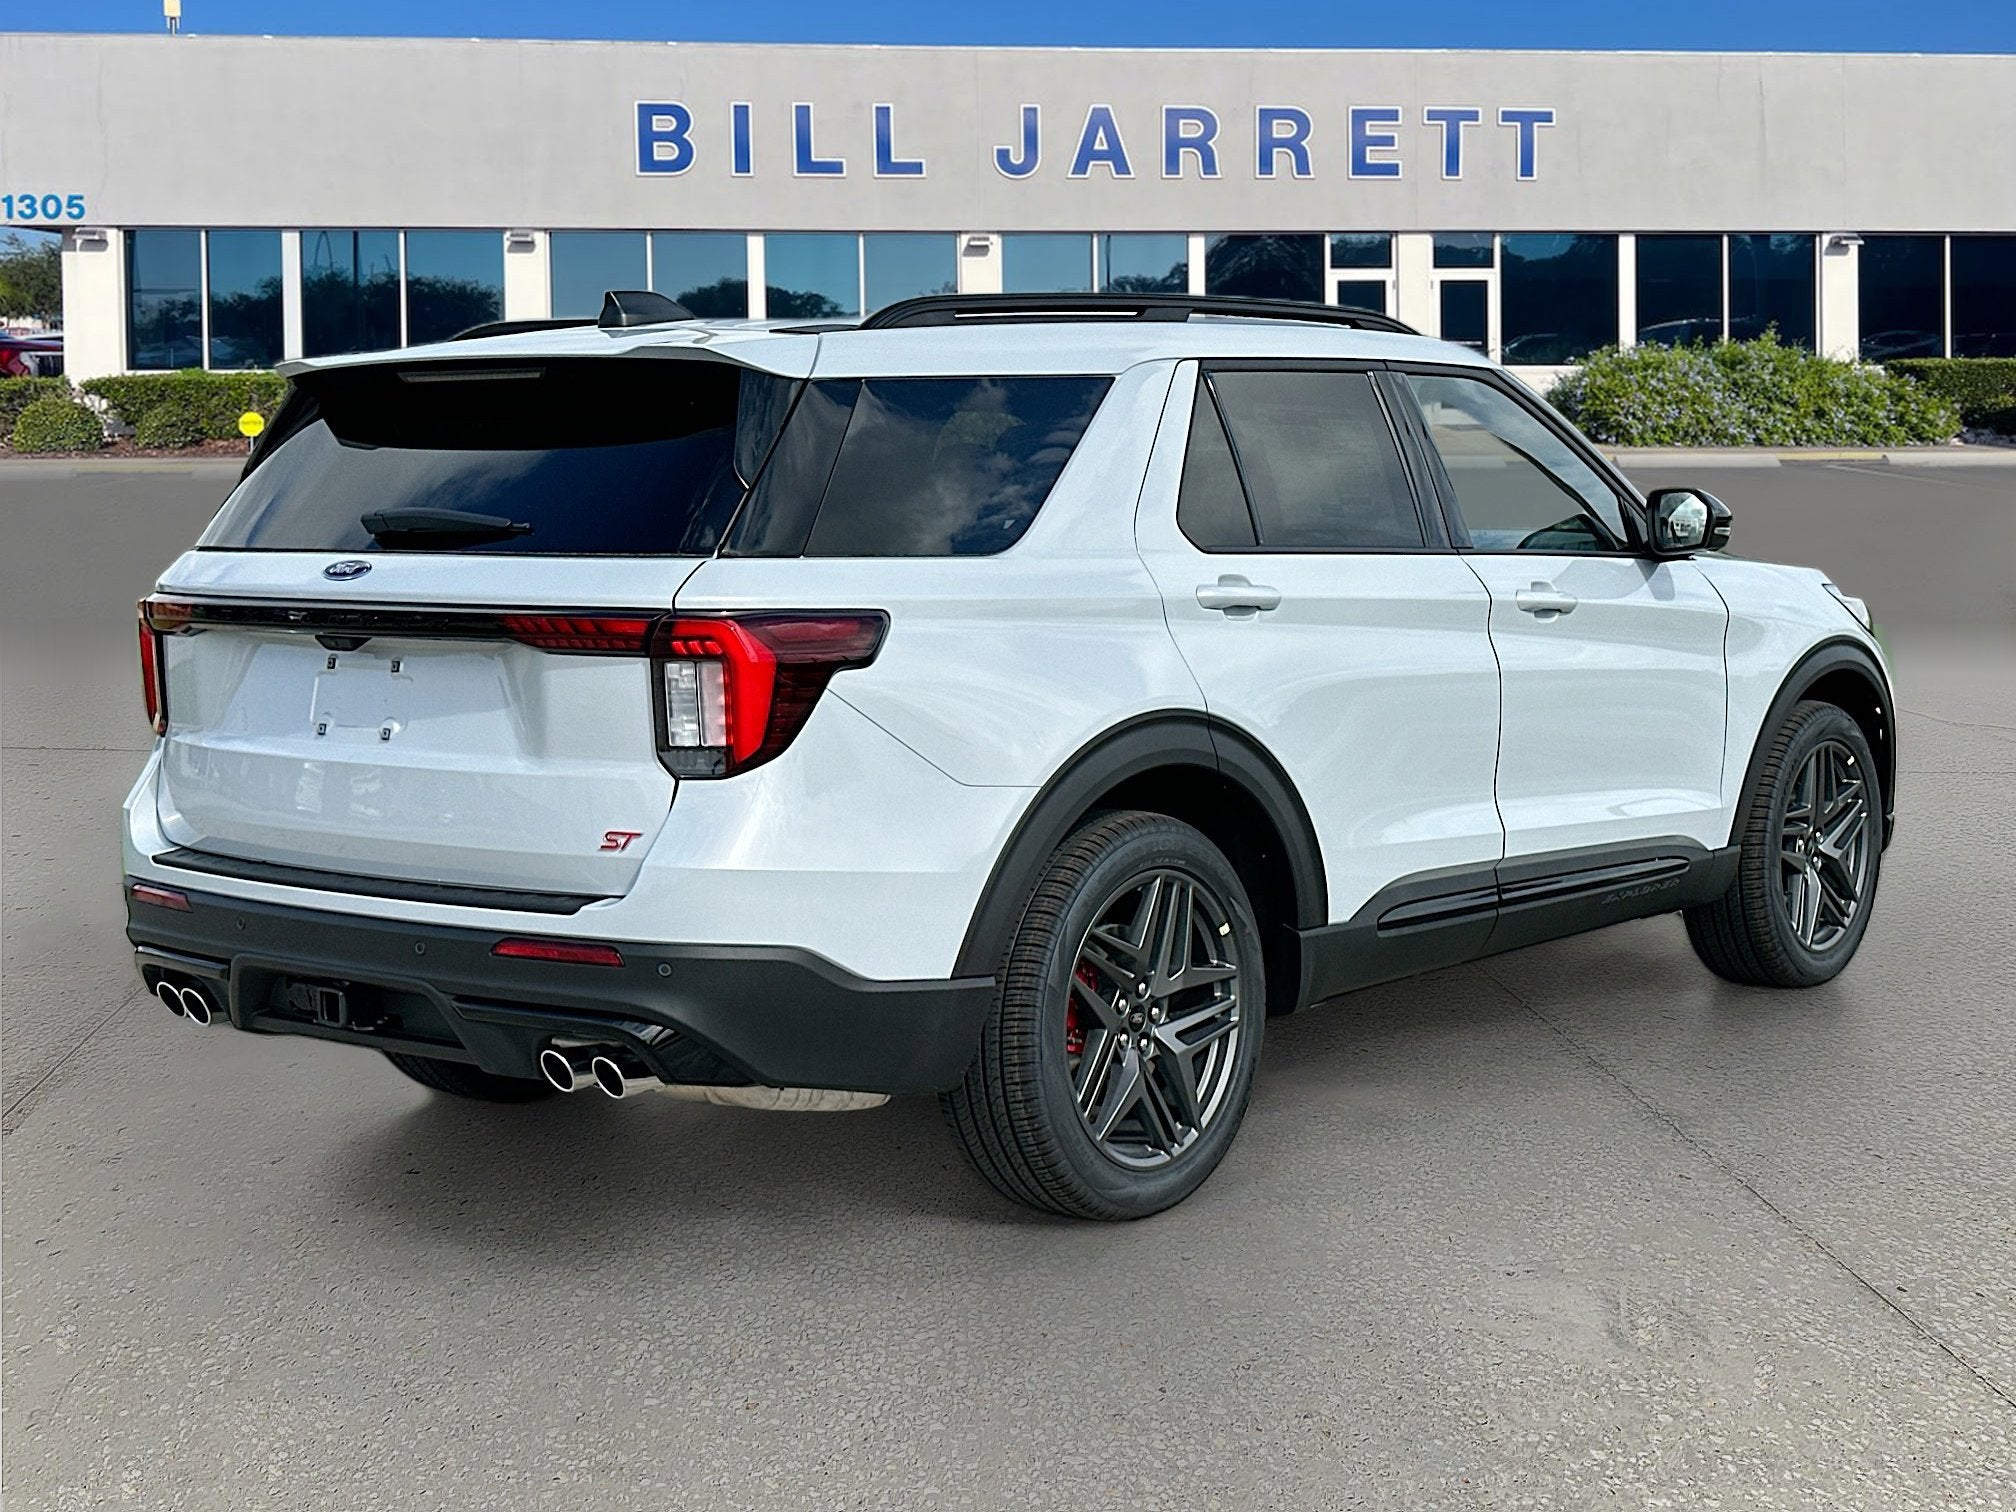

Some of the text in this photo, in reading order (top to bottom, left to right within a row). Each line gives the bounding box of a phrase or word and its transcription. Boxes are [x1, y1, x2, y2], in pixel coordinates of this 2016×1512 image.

[635, 100, 1557, 181] BILL JARRETT
[1, 193, 86, 220] 1305
[599, 831, 643, 852] ST
